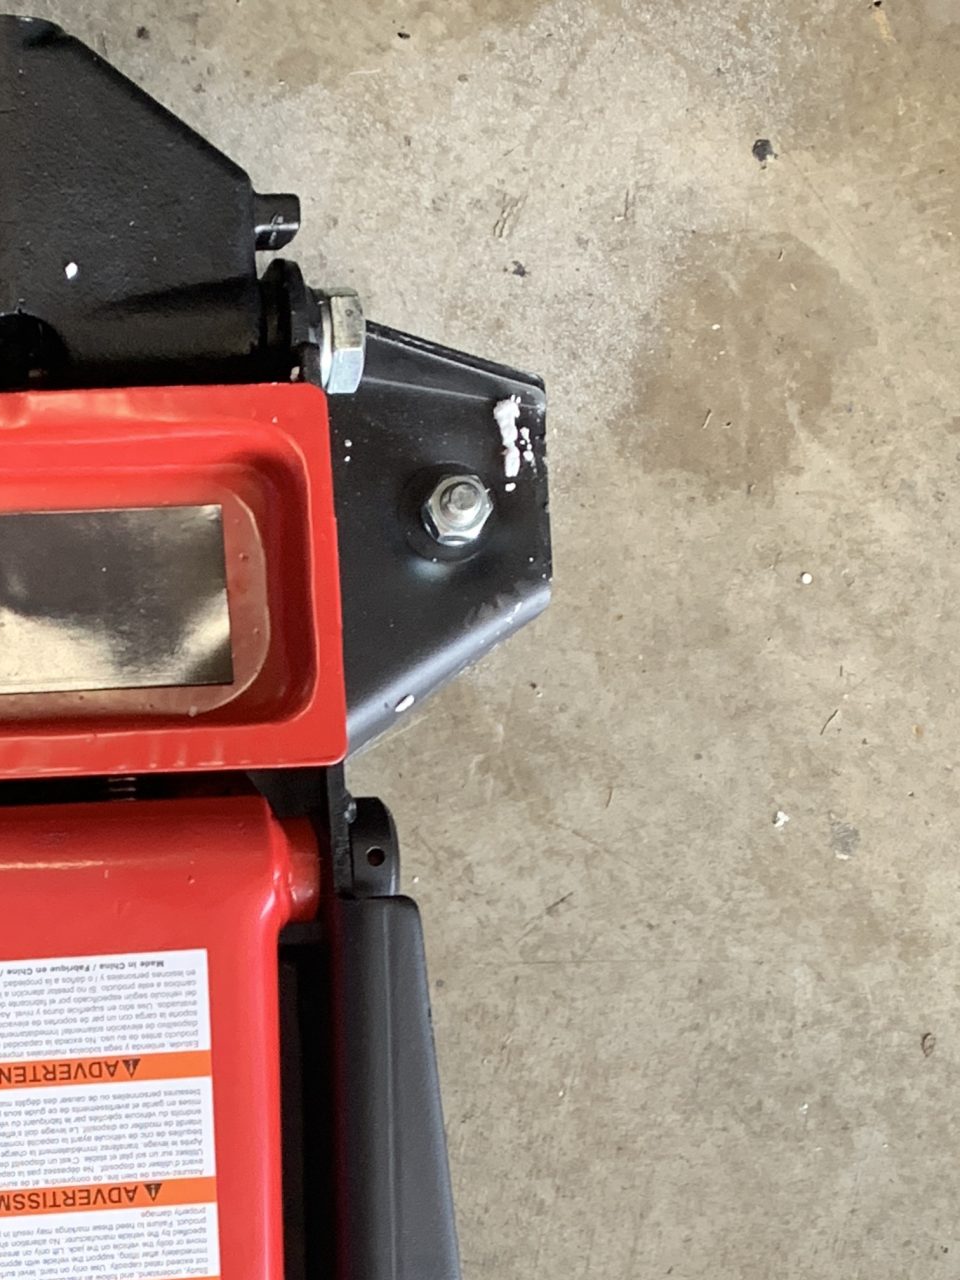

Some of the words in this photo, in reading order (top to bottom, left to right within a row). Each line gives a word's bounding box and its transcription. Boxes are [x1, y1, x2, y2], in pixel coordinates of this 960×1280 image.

[48, 963, 90, 974] Fabrique
[91, 963, 96, 971] /
[98, 961, 126, 971] China
[138, 959, 164, 968] Made
[5, 967, 33, 977] Chine
